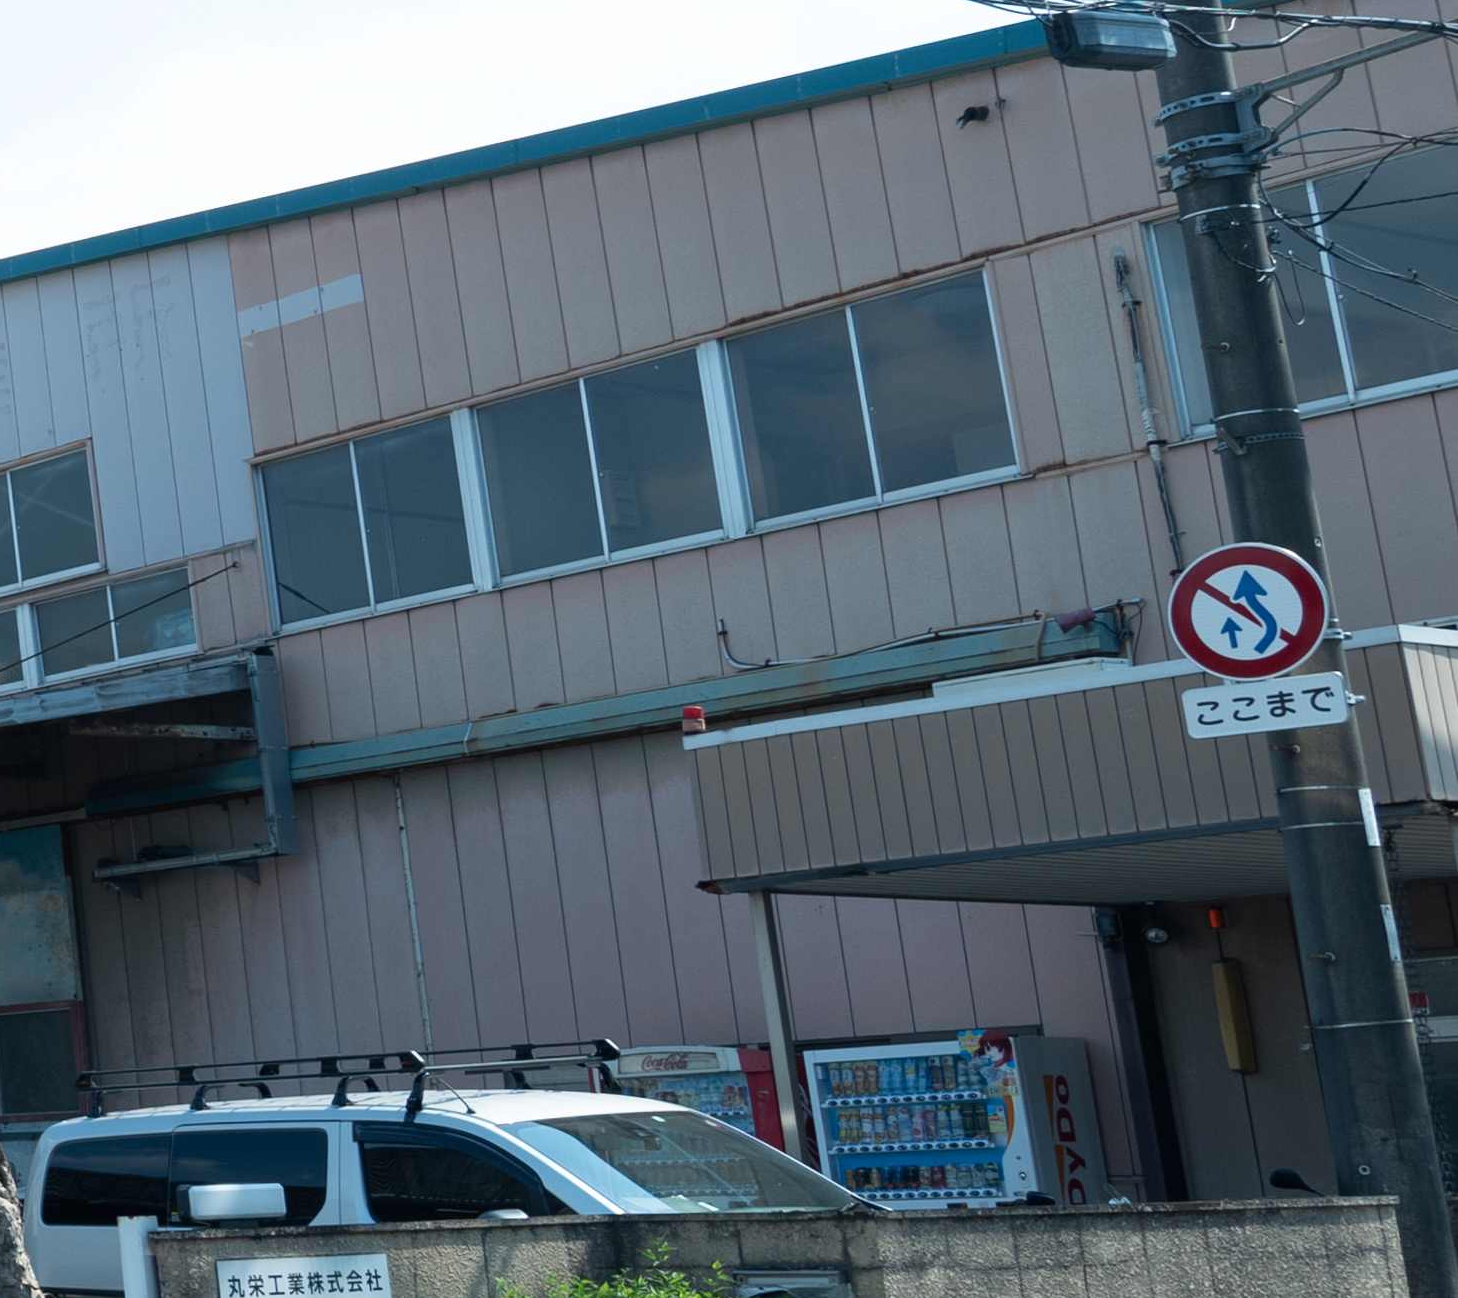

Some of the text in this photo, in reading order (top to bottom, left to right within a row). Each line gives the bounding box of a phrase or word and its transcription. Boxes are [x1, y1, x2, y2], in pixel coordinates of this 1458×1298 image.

[1197, 686, 1335, 725] ここまで
[227, 1268, 384, 1298] 丸栄工業株式会社
